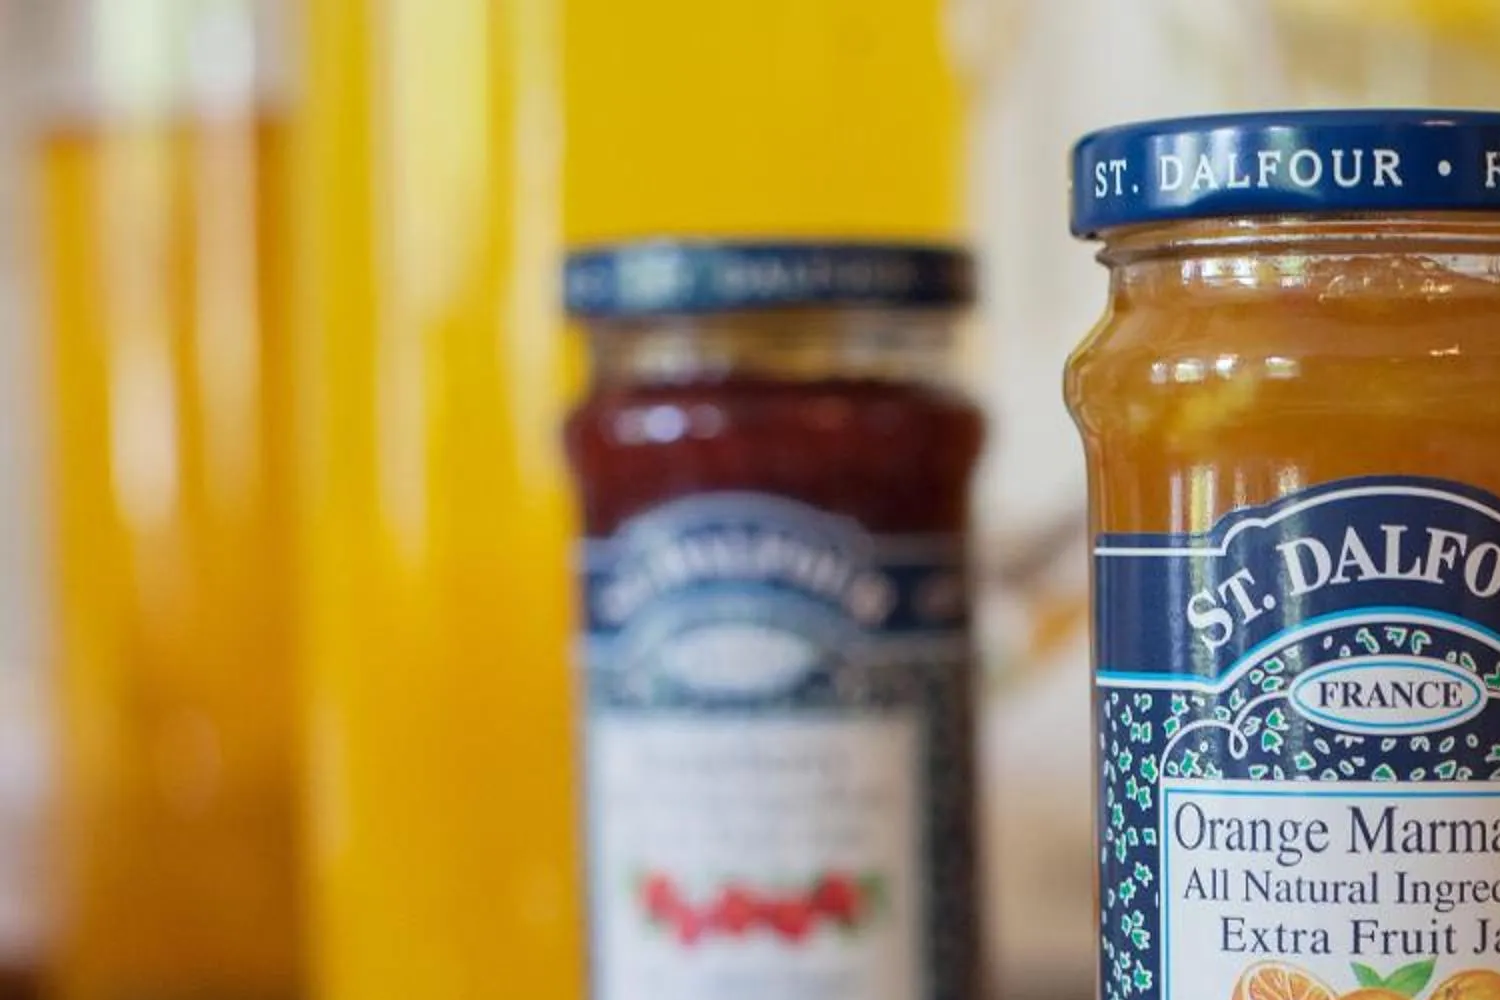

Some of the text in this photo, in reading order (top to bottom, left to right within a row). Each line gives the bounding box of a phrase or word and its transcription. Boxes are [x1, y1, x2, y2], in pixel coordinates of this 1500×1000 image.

[1094, 158, 1139, 197] ST.
[1159, 148, 1404, 190] DALFOUR
[1186, 568, 1276, 652] ST.
[1318, 680, 1466, 709] FRANCE
[1174, 801, 1331, 867] Orange
[1183, 867, 1230, 901] All
[1243, 869, 1380, 905] Natural
[1220, 916, 1333, 955] Extra
[1348, 917, 1457, 956] Fruit
